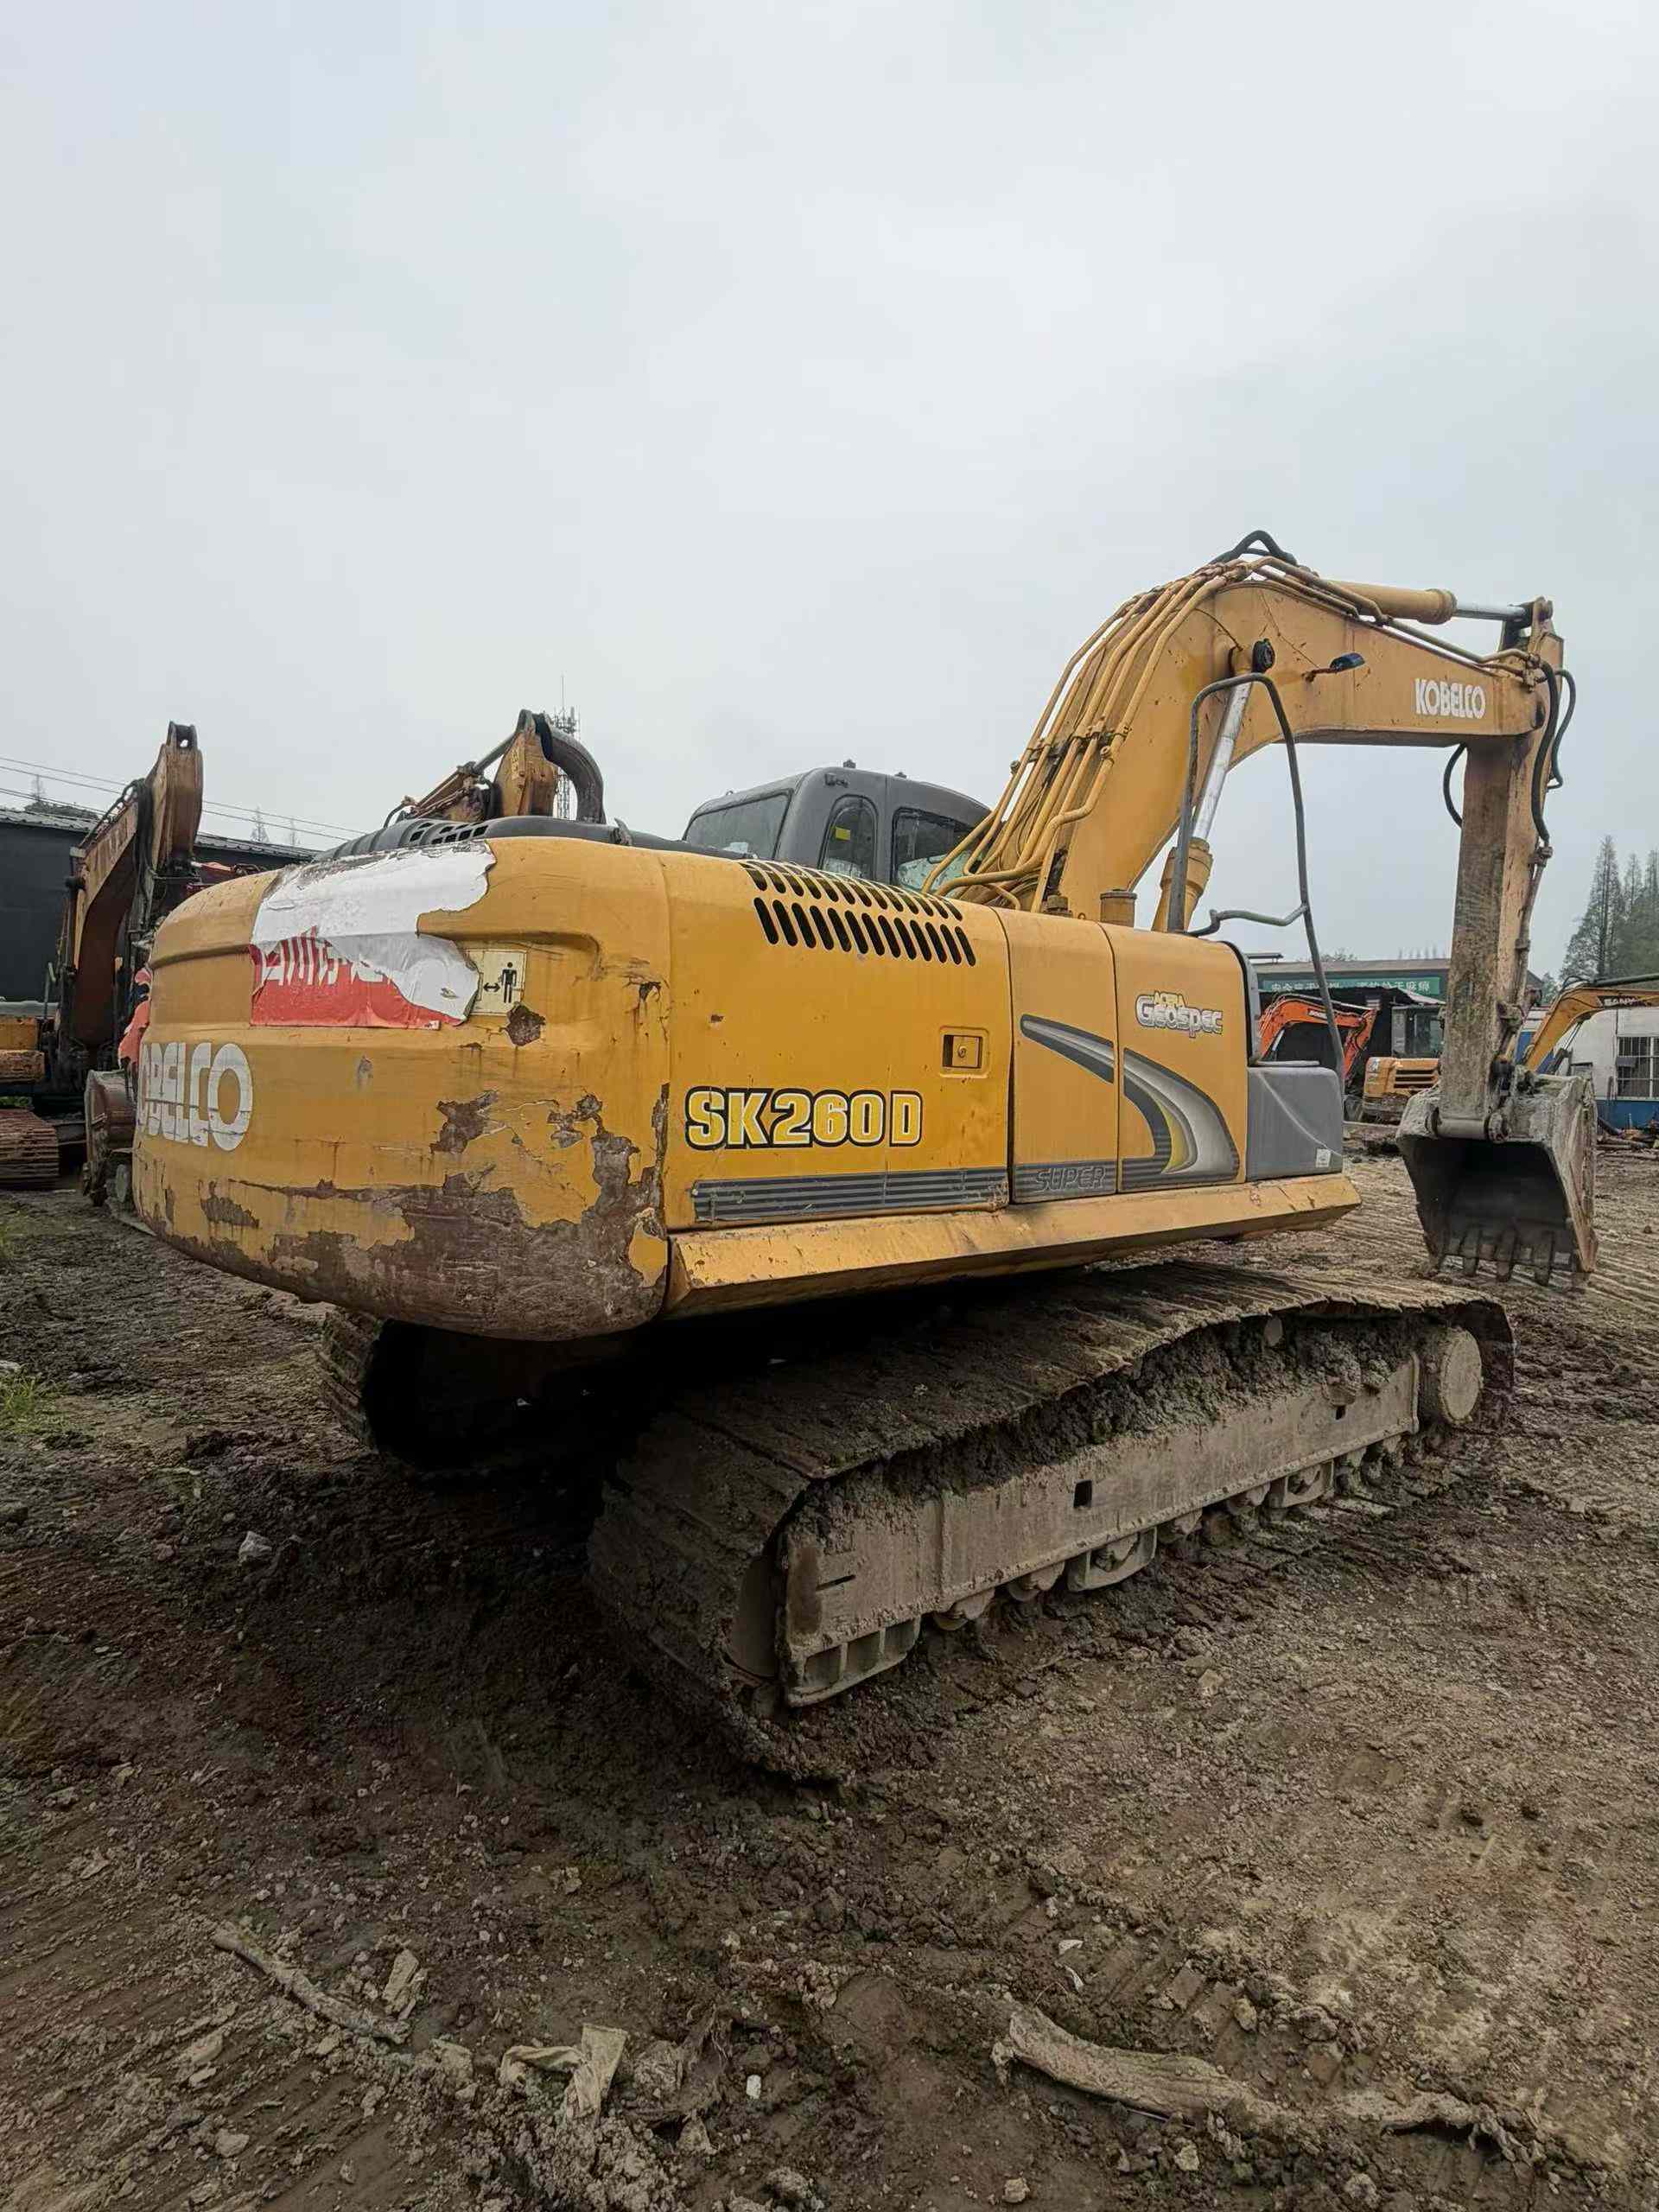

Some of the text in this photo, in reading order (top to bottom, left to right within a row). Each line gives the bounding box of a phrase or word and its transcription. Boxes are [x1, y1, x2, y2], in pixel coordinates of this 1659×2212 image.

[1414, 677, 1486, 719] KOBELCO
[137, 1041, 253, 1152] OBELCO
[685, 1085, 922, 1150] SK260D
[1036, 1166, 1106, 1192] SUPER
